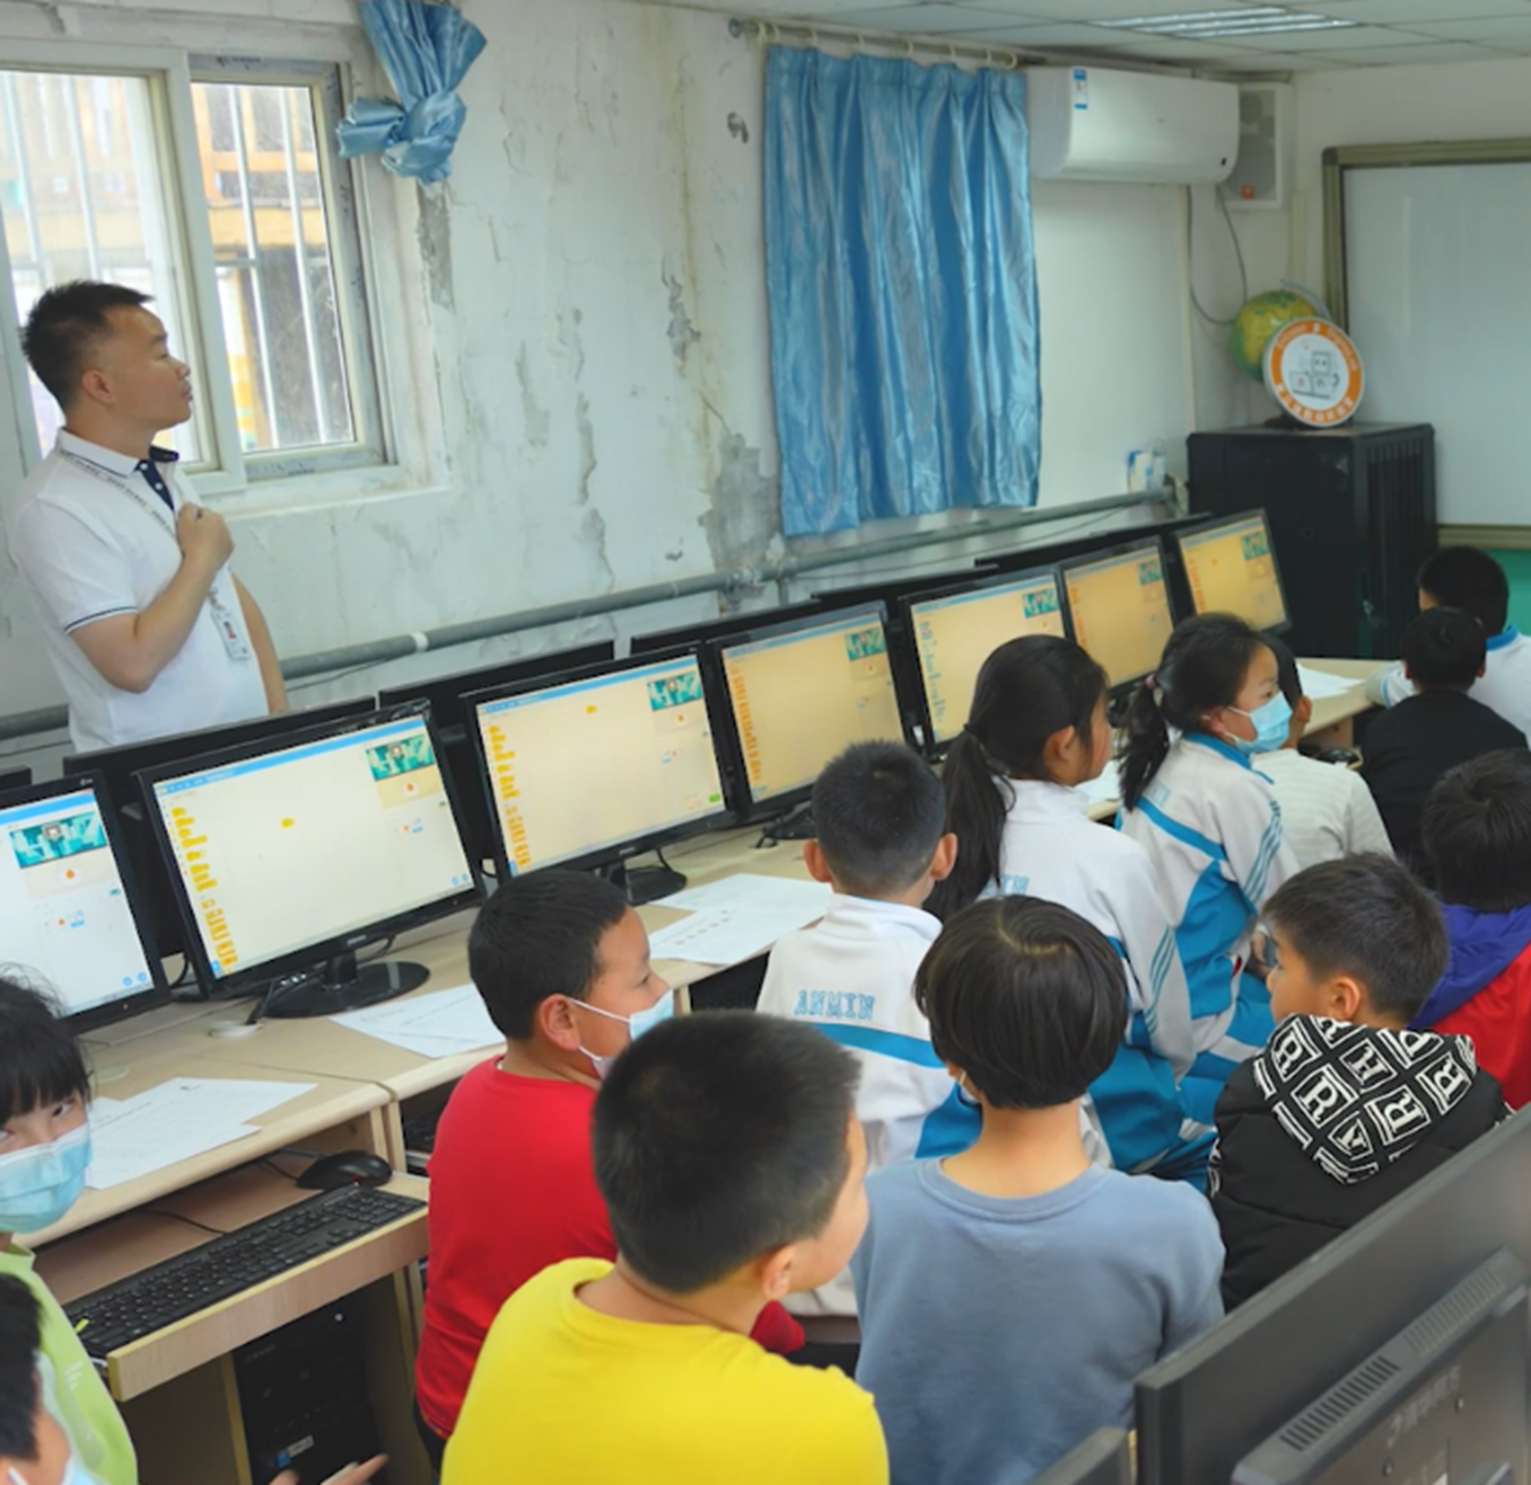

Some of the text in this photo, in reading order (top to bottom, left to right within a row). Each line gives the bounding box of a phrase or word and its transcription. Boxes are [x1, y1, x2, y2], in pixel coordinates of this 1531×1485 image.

[794, 989, 876, 1020] ANMIN
[1299, 1075, 1338, 1122] R
[1383, 1092, 1425, 1134] R
